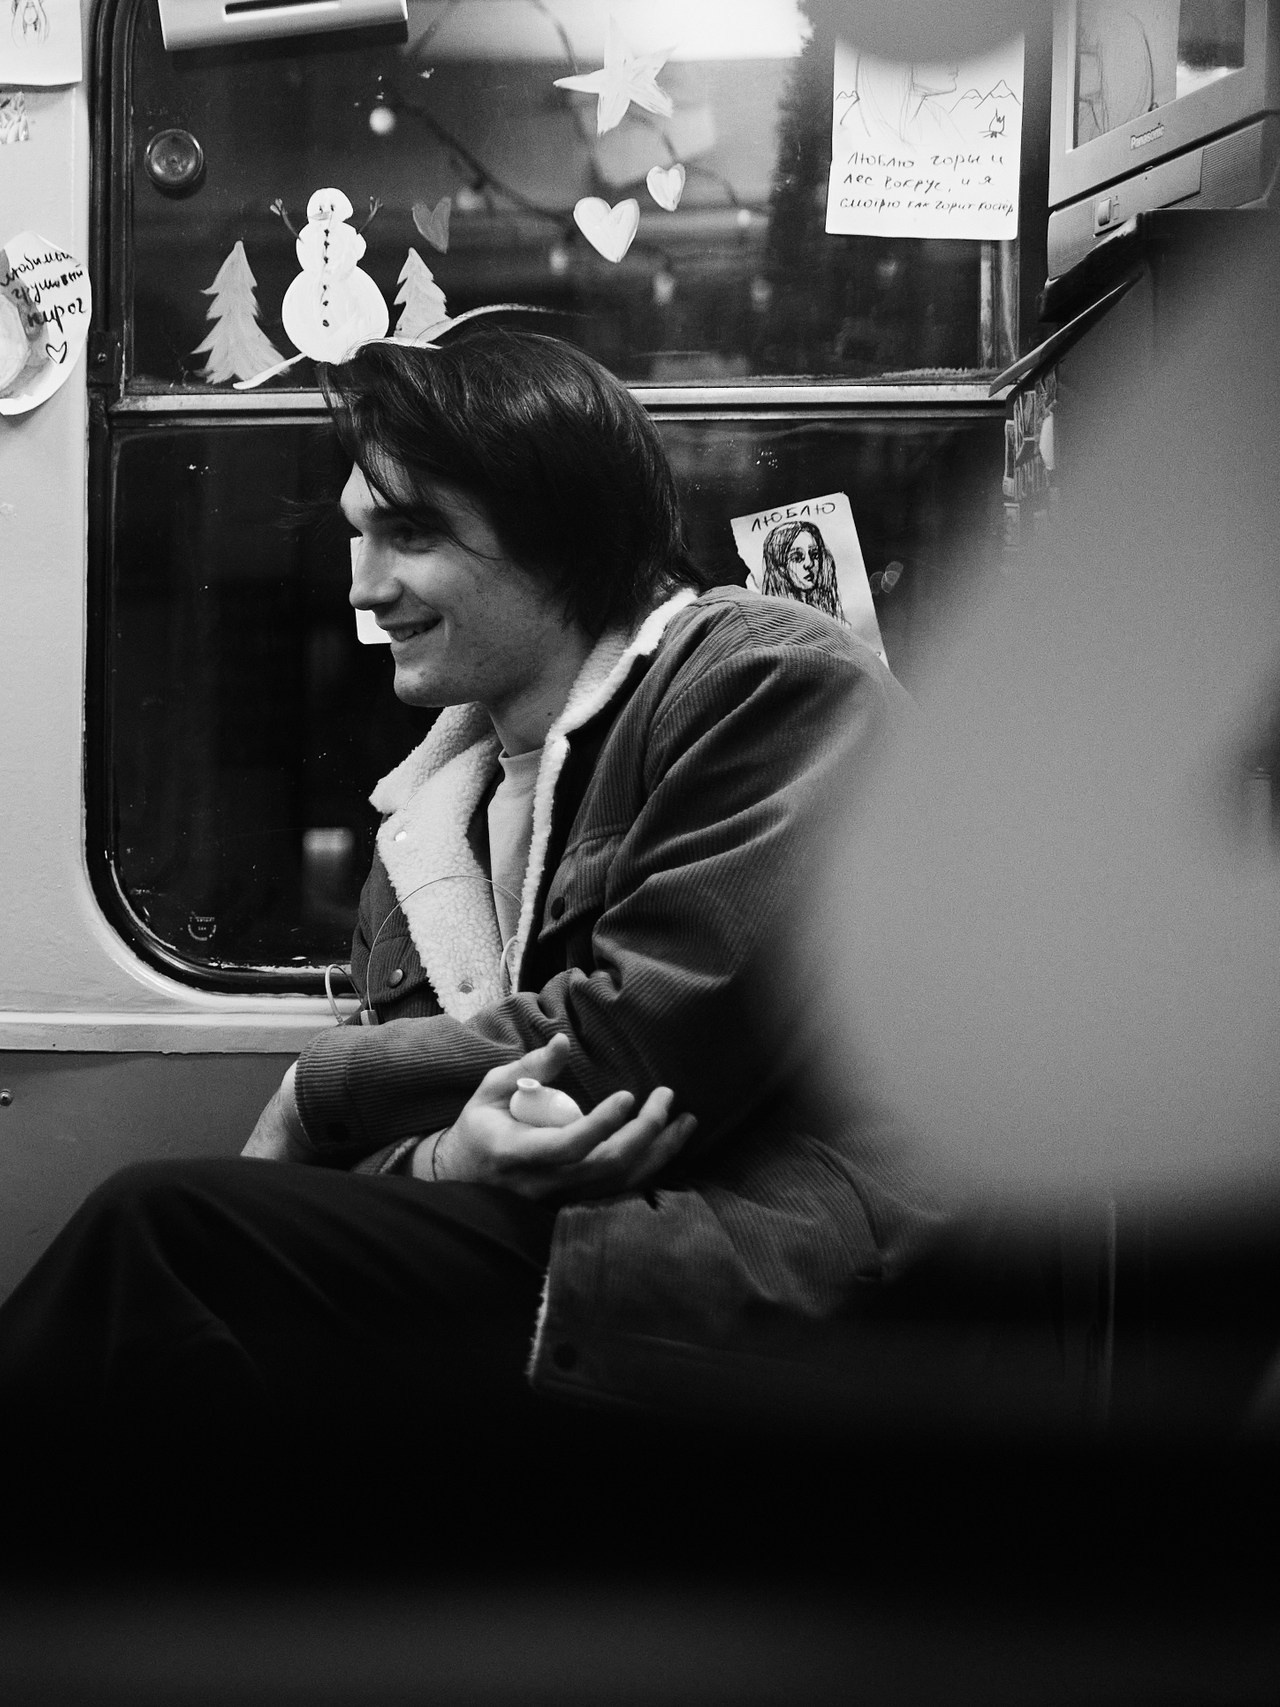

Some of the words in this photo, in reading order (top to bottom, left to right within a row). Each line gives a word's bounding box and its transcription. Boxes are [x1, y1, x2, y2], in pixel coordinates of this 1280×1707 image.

[1130, 124, 1165, 150] Panasonic
[930, 154, 981, 172] горы
[991, 154, 1004, 165] и
[961, 177, 971, 186] и
[978, 175, 995, 186] я
[839, 198, 901, 214] смотрю
[907, 200, 929, 210] как
[935, 200, 973, 215] горит
[26, 297, 87, 334] пирог
[752, 502, 836, 533] ЛЮБЛЮ
